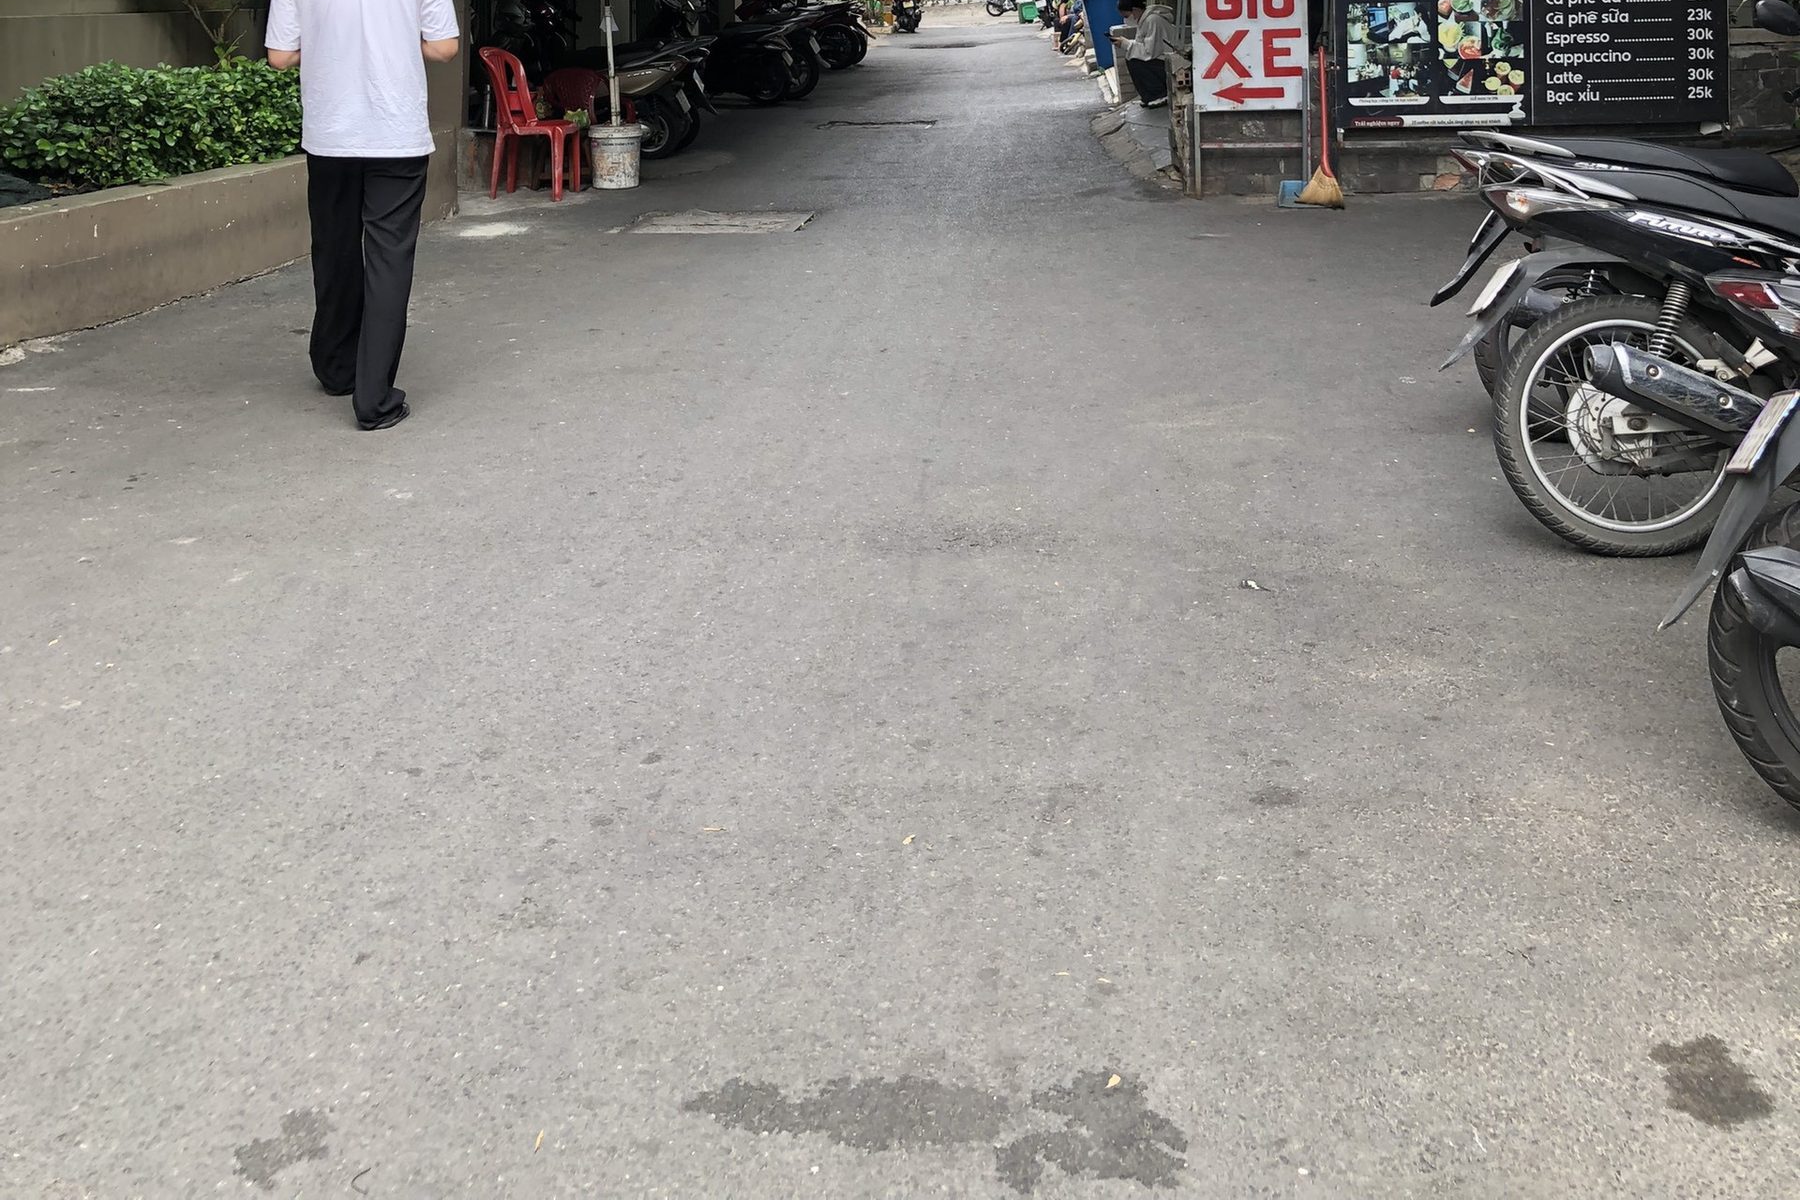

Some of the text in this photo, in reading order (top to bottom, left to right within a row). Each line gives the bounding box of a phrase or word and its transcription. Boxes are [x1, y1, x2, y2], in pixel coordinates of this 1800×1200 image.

[1546, 8, 1712, 28] Cà phê sữa 23k
[1546, 27, 1714, 48] Espresso 30k
[1201, 28, 1303, 80] XE
[1546, 47, 1715, 67] Cappuccino 30k
[1546, 68, 1714, 85] Latte 30k
[1546, 84, 1713, 105] Bạc xỉu 25k
